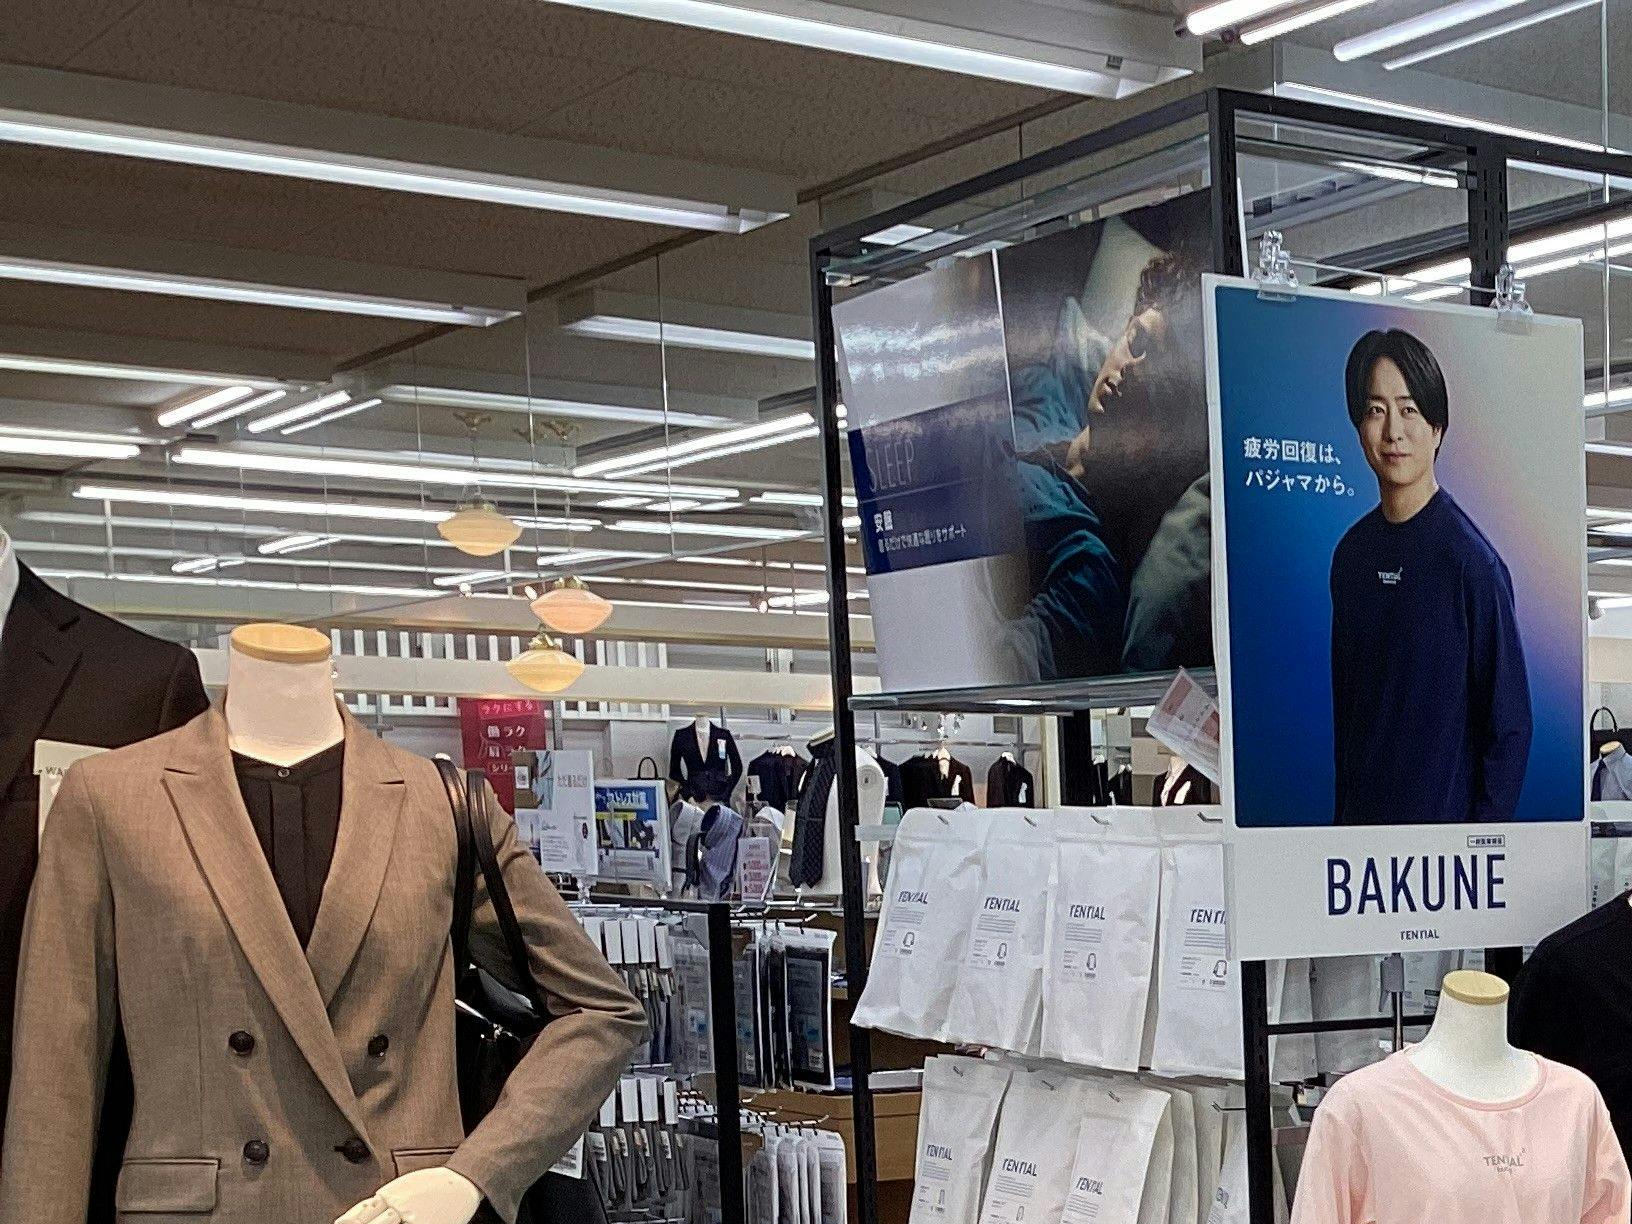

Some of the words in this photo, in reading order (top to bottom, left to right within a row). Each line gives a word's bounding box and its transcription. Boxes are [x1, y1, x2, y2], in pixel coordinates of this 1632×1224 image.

[1243, 436, 1342, 464] 疲労回復は、
[866, 438, 915, 493] SLEEP
[1245, 468, 1354, 496] パジャマから。
[1326, 853, 1507, 916] BAKUNE
[983, 897, 1021, 913] TENTIAL
[1069, 904, 1106, 921] TENTIAL
[1189, 908, 1226, 925] TENTI
[1400, 929, 1440, 941] TENTIAL
[1001, 1157, 1038, 1177] TENTIAL
